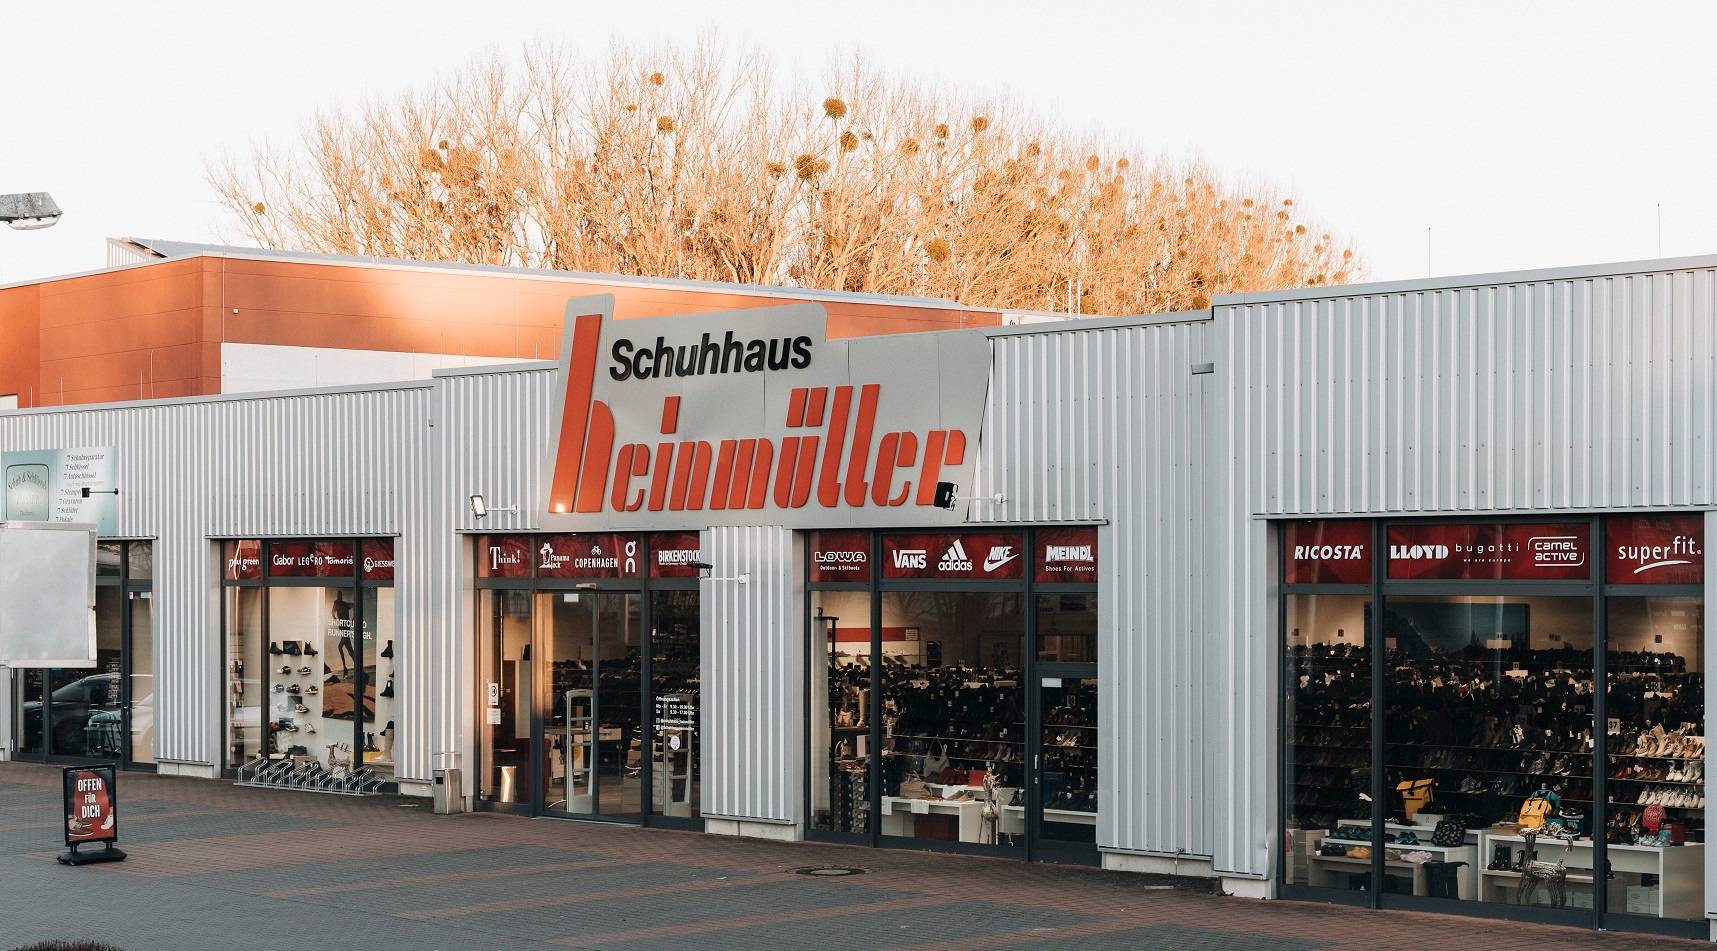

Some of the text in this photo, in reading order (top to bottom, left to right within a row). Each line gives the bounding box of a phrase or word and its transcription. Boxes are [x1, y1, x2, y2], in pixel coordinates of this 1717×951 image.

[608, 330, 812, 382] Schuhhaus
[988, 546, 1013, 560] NIKE
[1045, 544, 1094, 562] MEINDL
[1390, 545, 1449, 560] LLOYD
[1455, 543, 1519, 554] bugatti
[273, 554, 295, 566] Gabor
[658, 550, 700, 562] BIRKENSTOCK
[814, 551, 867, 562] LOWA
[574, 557, 619, 569] COPENHAGEN
[938, 560, 973, 571] adidas
[1609, 720, 1617, 729] 37
[78, 778, 102, 792] OFFEN
[84, 793, 96, 803] FÜR
[82, 805, 100, 818] DICH
